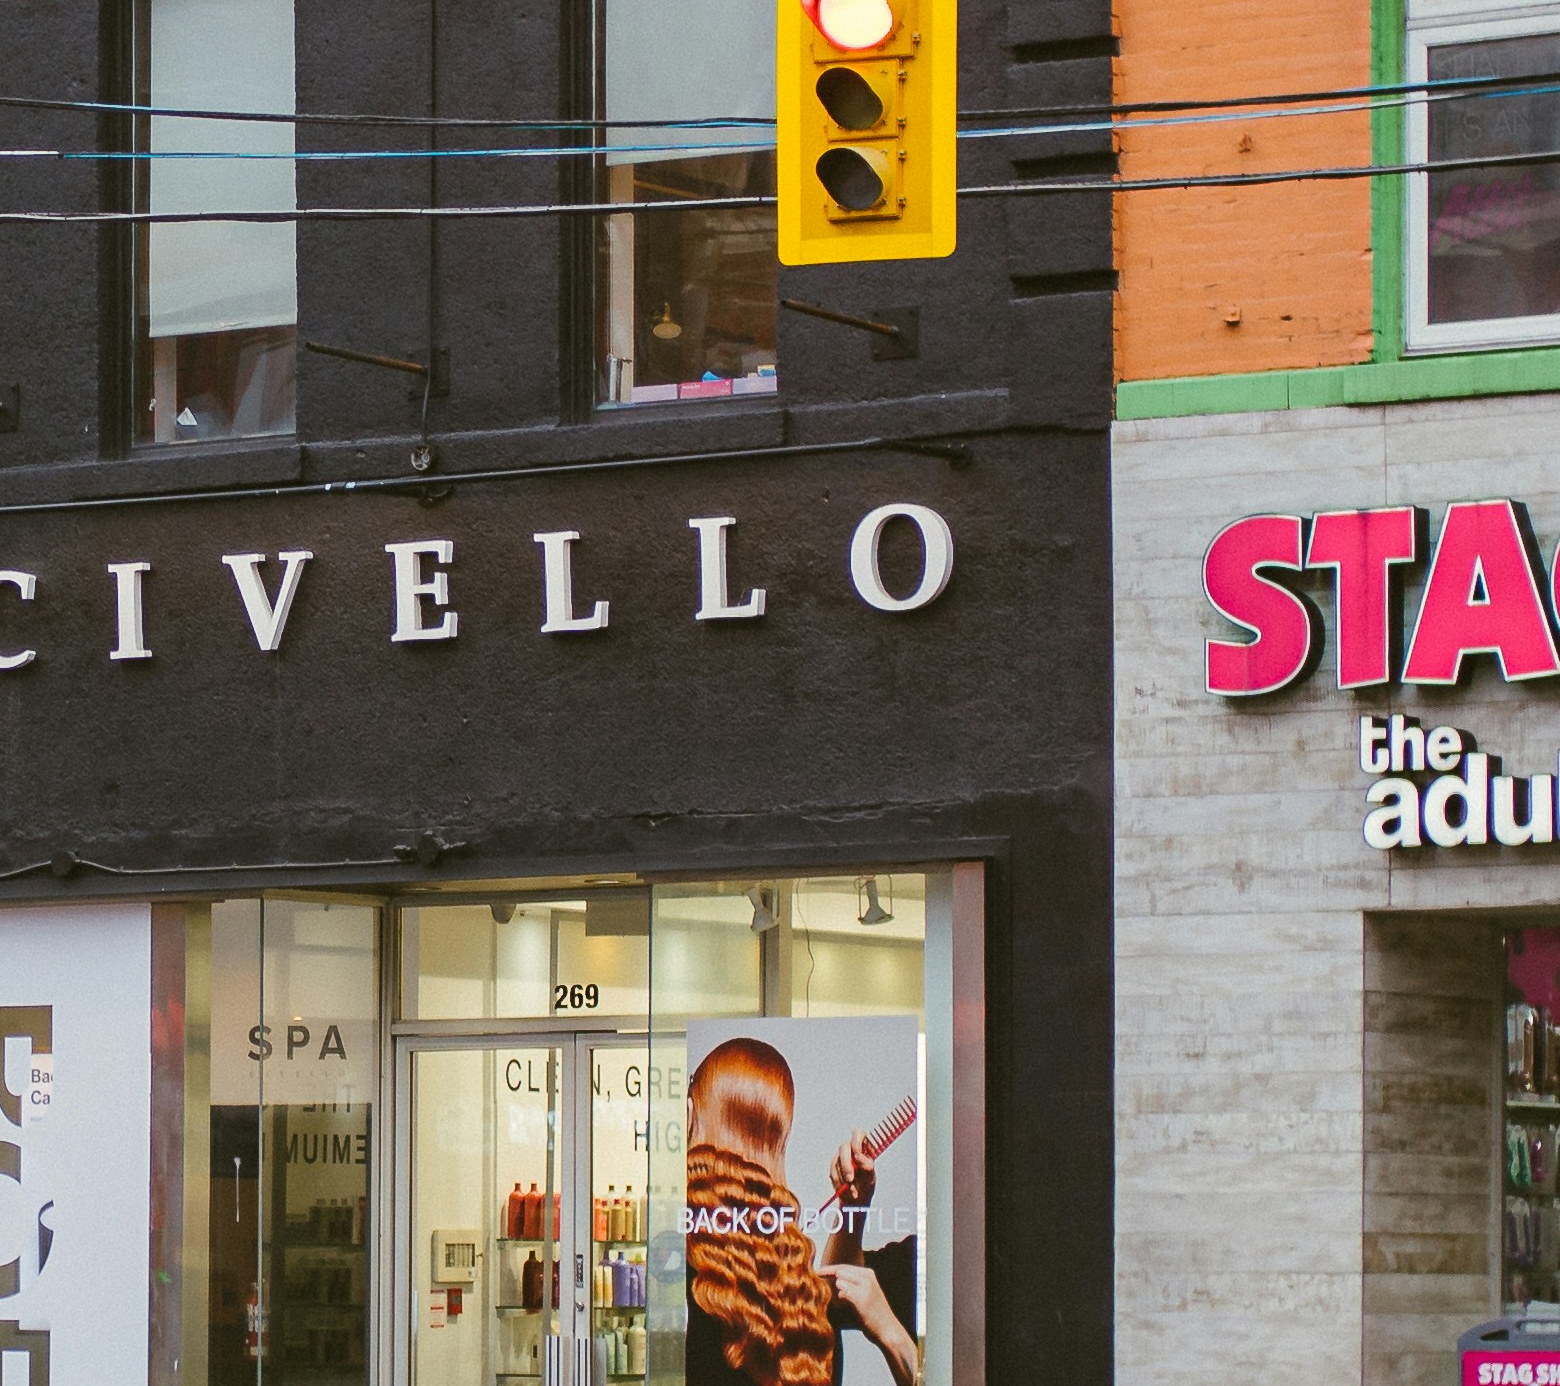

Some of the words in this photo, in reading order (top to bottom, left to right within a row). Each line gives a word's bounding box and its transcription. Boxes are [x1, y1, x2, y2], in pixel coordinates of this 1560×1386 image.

[1359, 713, 1464, 774] the
[554, 983, 600, 1010] 269
[247, 1024, 348, 1062] SPA
[676, 1206, 751, 1235] BACK
[756, 1206, 796, 1235] OF
[803, 1205, 913, 1235] BOTTLE
[1478, 1362, 1534, 1386] STAG
